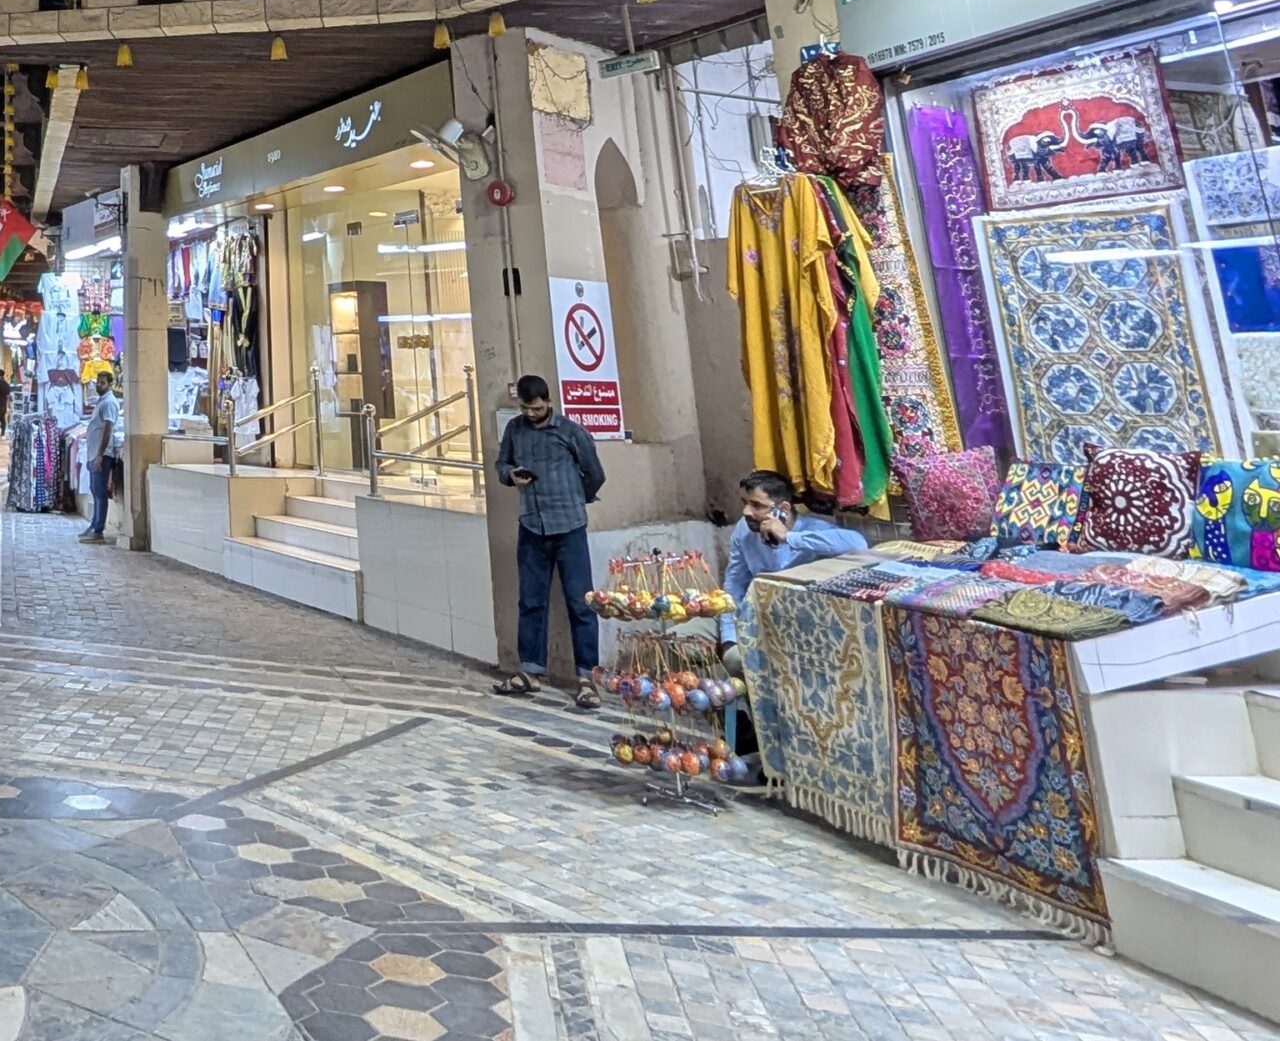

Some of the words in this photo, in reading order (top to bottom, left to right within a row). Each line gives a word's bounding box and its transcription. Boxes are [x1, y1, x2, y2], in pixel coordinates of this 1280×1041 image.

[928, 31, 946, 47] 2015
[566, 384, 593, 401] التدخين
[593, 385, 616, 402] ممنوع
[581, 413, 618, 427] SMOKING
